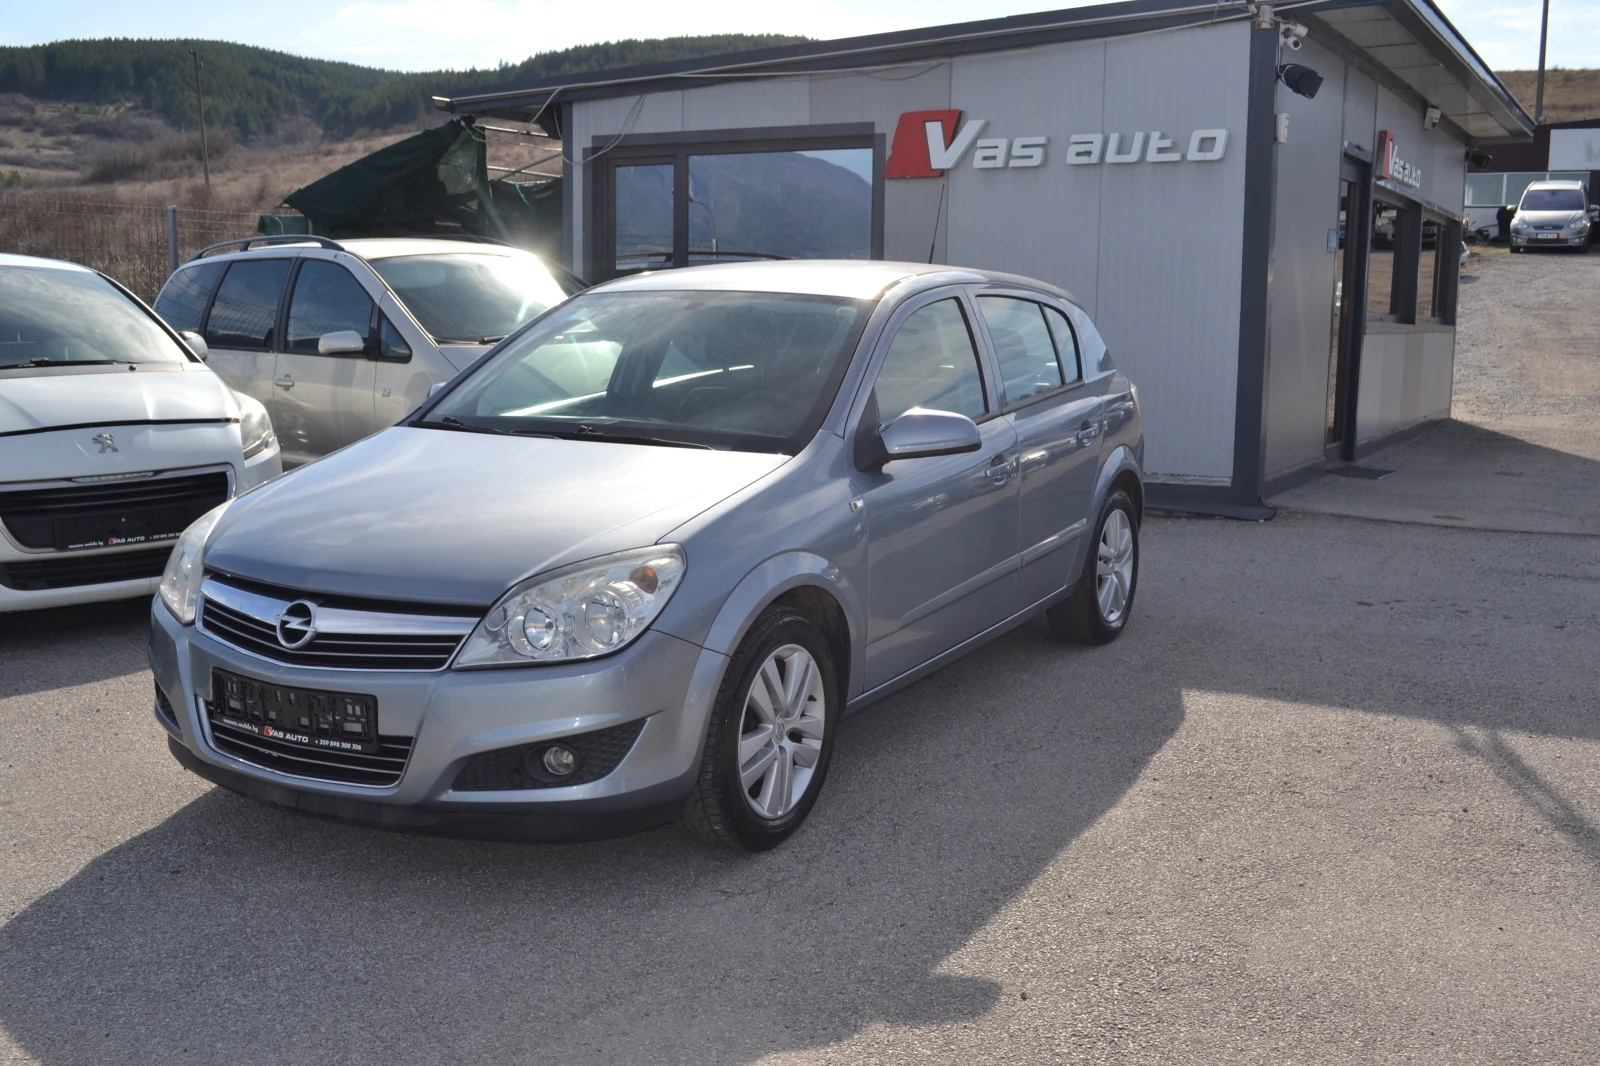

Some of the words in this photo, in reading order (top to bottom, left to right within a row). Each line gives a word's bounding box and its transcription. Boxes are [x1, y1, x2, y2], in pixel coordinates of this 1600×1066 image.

[924, 118, 1049, 171] Vas
[1065, 127, 1230, 166] auto
[1388, 140, 1405, 181] Vas
[1403, 162, 1422, 189] auto
[127, 535, 145, 543] AUTO
[285, 733, 309, 743] AUTO
[329, 740, 339, 748] 898
[351, 743, 362, 751] 306
